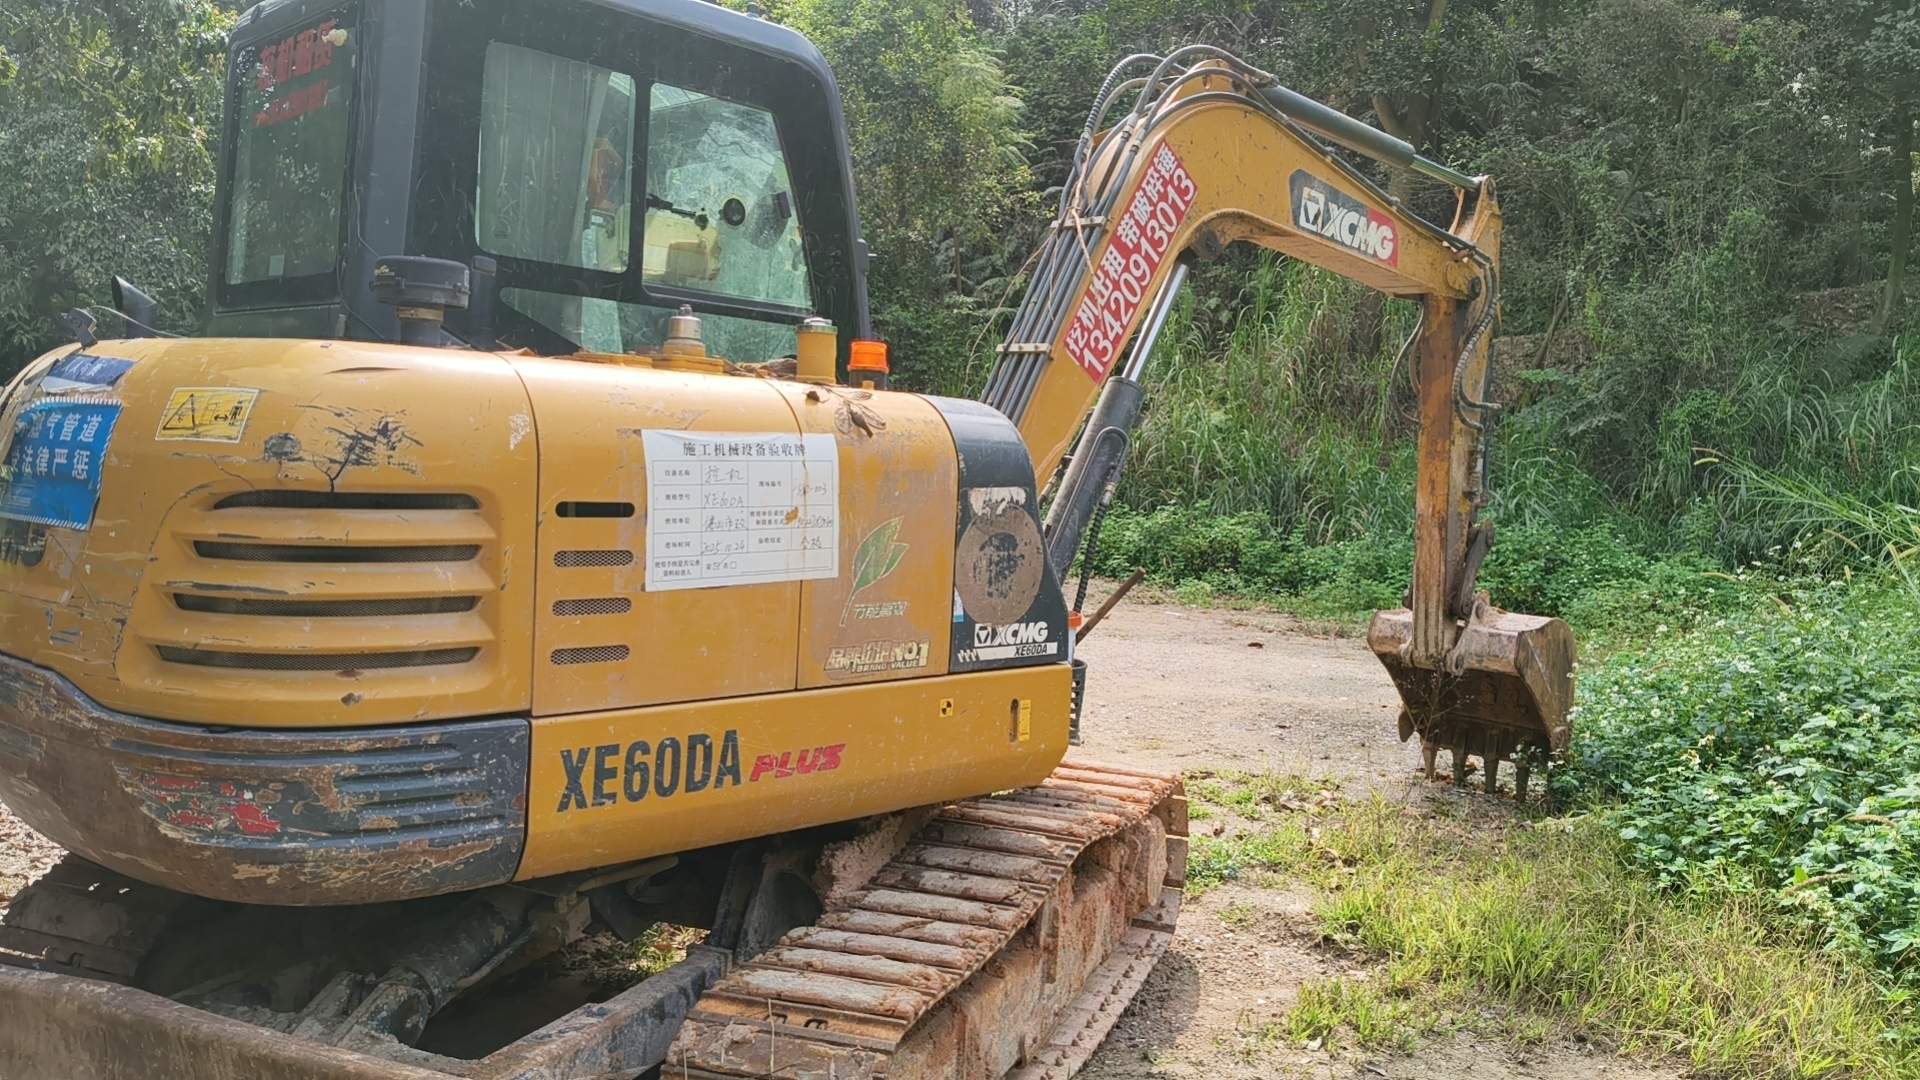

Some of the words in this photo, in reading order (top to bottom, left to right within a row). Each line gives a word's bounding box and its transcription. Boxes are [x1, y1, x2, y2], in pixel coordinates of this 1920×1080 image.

[1066, 244, 1126, 356] 挖机出租
[1116, 142, 1178, 249] 带破碎锤
[1321, 202, 1394, 260] XCMG
[1083, 167, 1195, 373] 13420913013
[991, 621, 1048, 646] XCMG
[1014, 643, 1048, 657] XE60DA
[556, 729, 742, 813] XE60DA
[750, 744, 846, 782] PLUS
